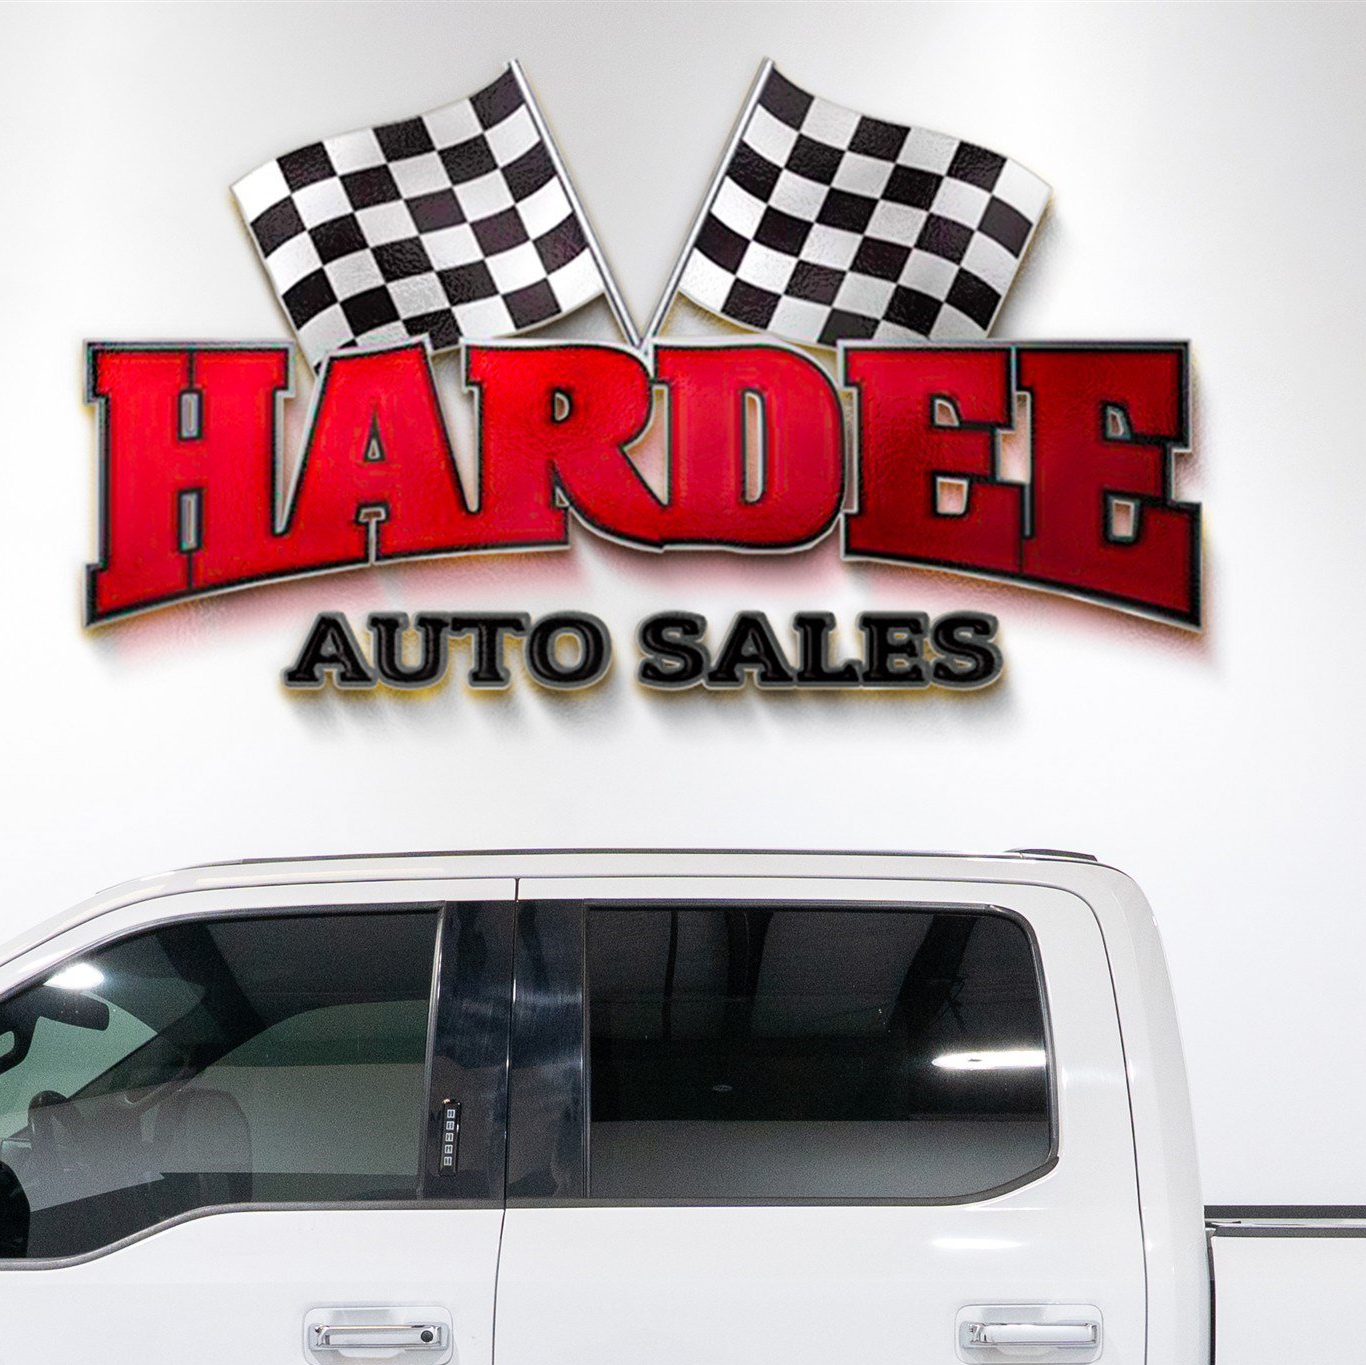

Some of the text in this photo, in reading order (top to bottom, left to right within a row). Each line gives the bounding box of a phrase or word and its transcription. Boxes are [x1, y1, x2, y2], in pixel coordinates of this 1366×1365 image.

[84, 336, 1204, 631] HARDEE
[282, 610, 1004, 692] AUTO SALES
